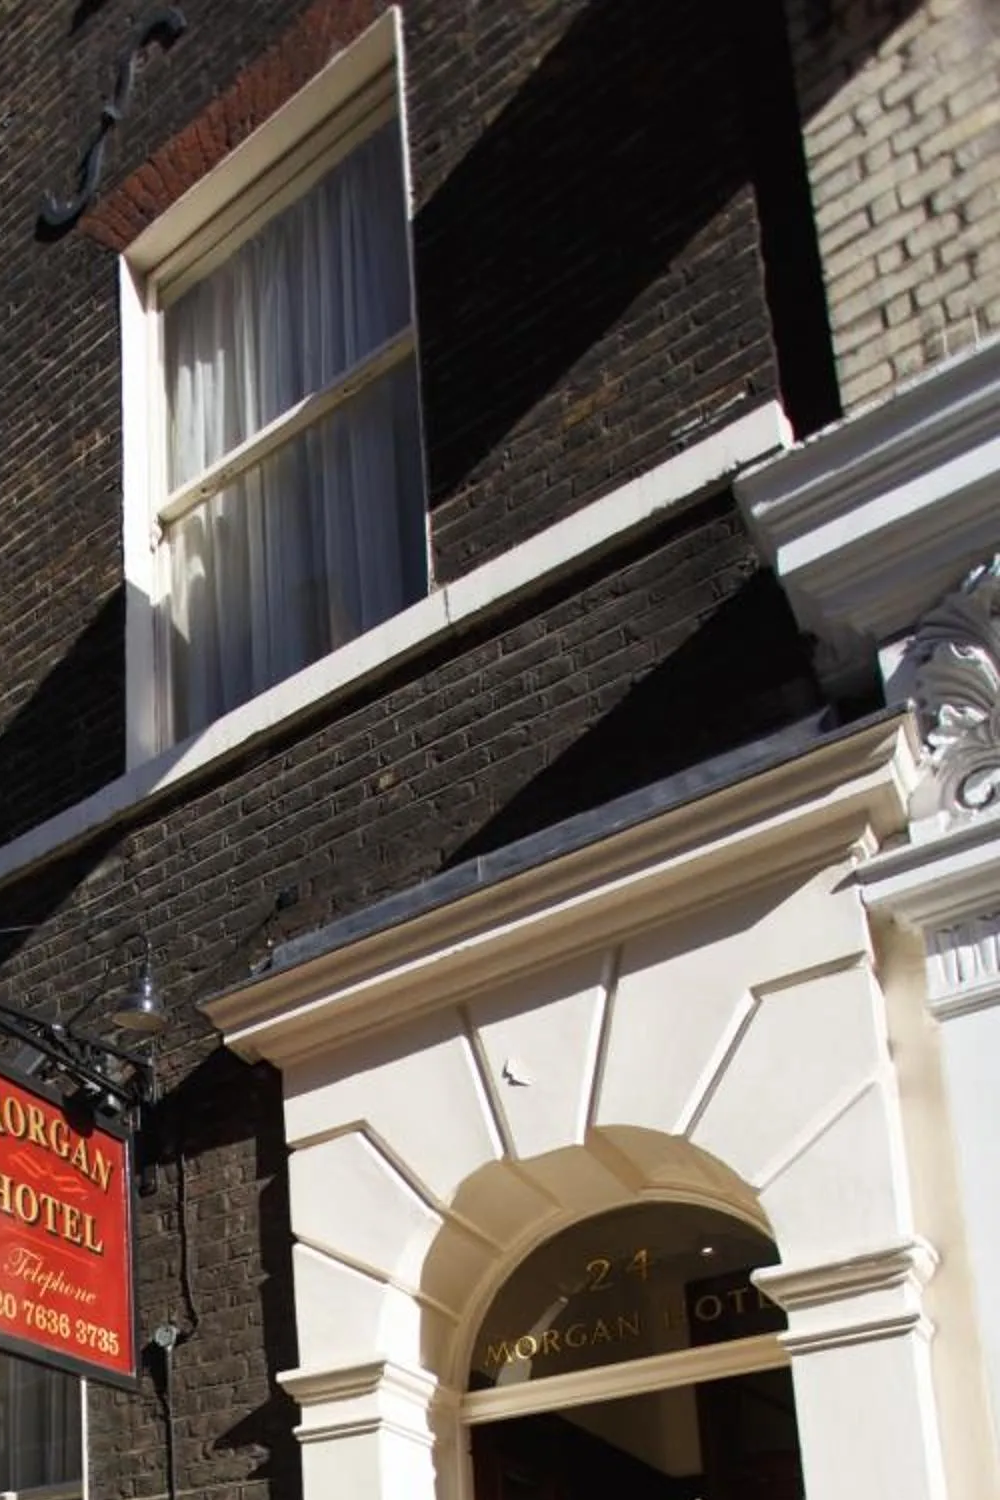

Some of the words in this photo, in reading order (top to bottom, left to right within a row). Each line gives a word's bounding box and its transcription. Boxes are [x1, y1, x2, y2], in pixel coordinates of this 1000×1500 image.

[3, 1247, 96, 1305] Telephone
[23, 1299, 71, 1339] 7636
[75, 1320, 120, 1356] 3735
[485, 1311, 641, 1367] MORGAN
